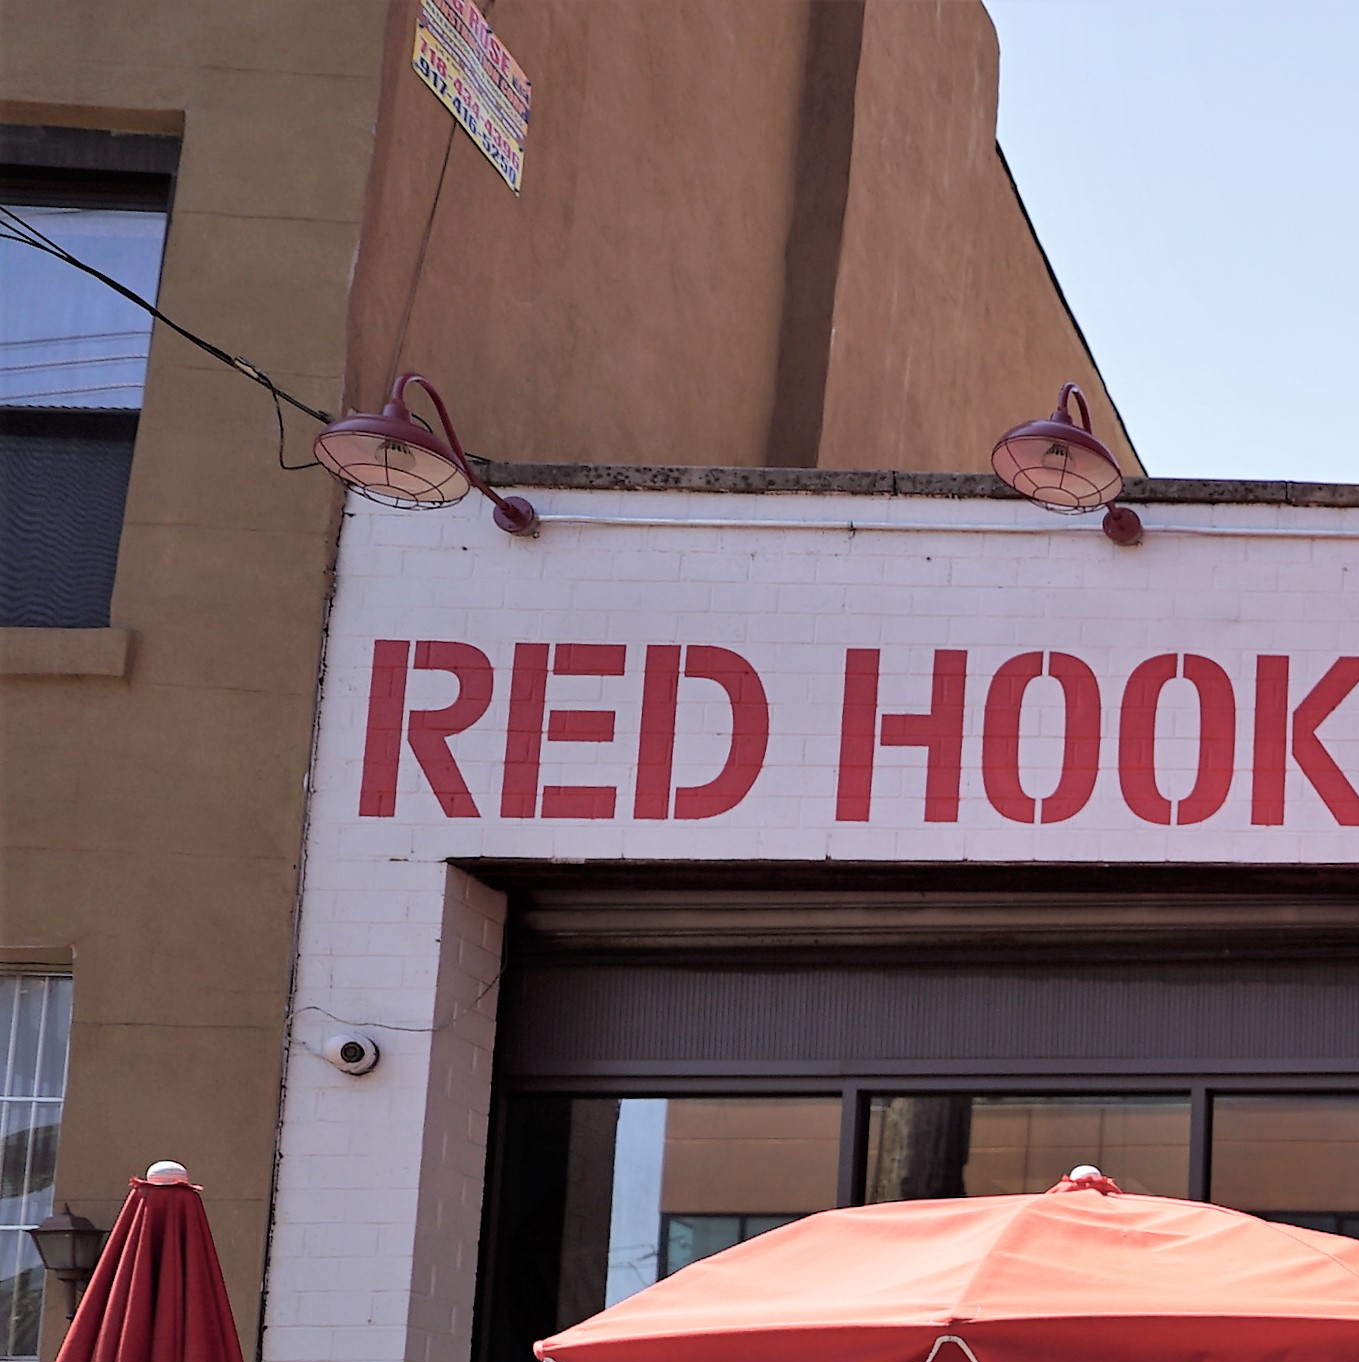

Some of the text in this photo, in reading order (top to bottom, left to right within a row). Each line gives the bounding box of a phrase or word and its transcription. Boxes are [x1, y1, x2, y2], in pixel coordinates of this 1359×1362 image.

[419, 35, 520, 171] 718-434-4396
[469, 6, 509, 80] ROSE
[418, 56, 517, 185] 917-416-5250
[359, 639, 769, 820] RED
